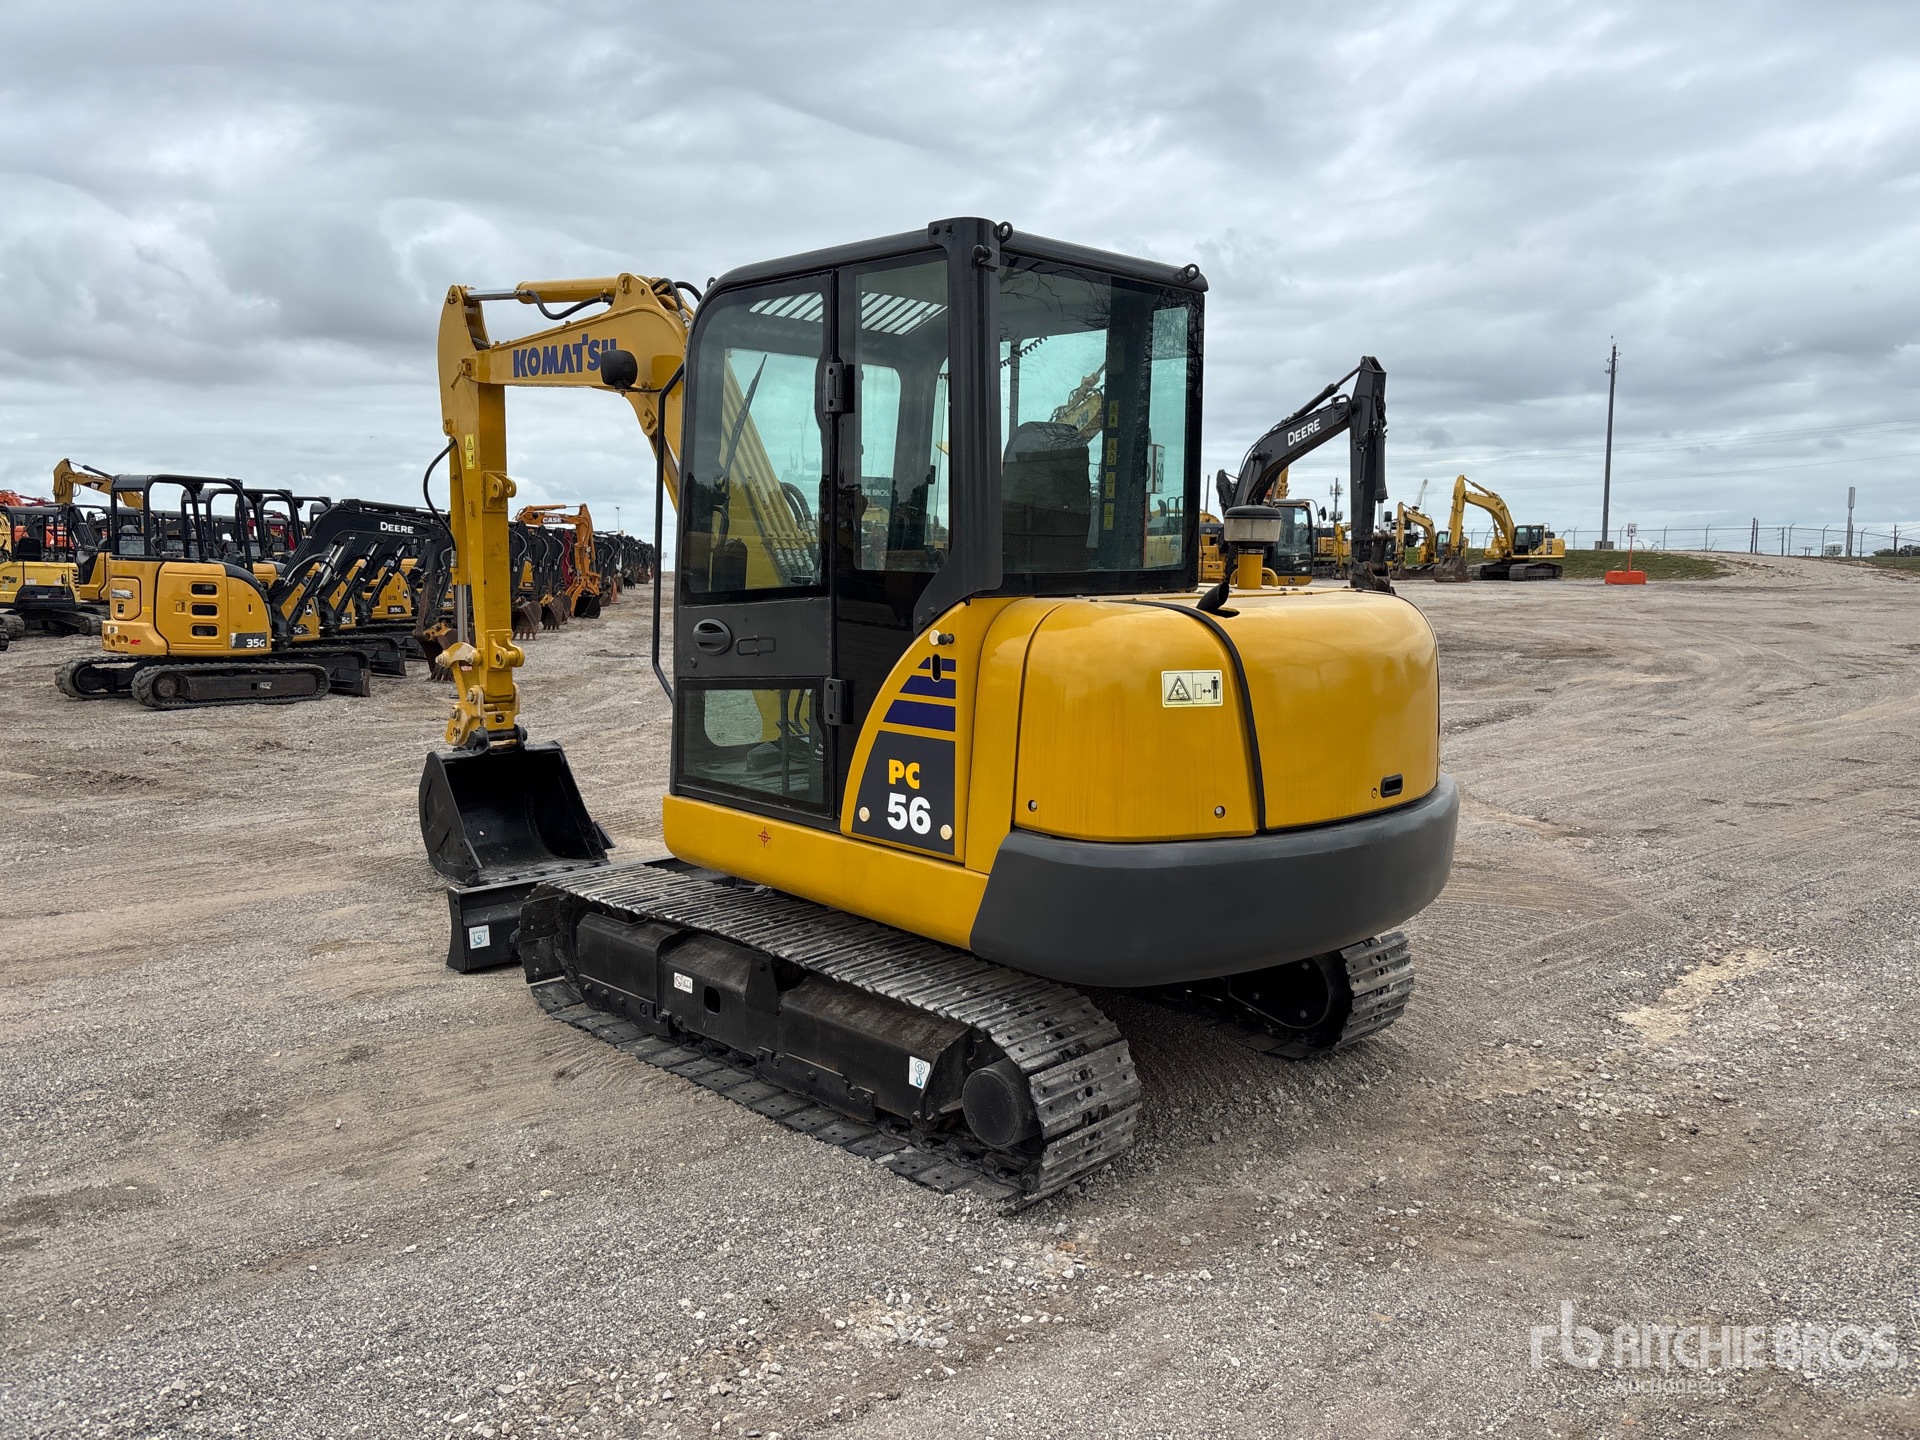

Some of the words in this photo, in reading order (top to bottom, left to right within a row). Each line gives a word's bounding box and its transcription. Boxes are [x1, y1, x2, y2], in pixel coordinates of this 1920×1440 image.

[1287, 418, 1321, 447] DEERE
[380, 521, 414, 534] DEERE
[245, 638, 266, 648] 35G
[888, 759, 921, 790] PC
[887, 792, 931, 835] 56
